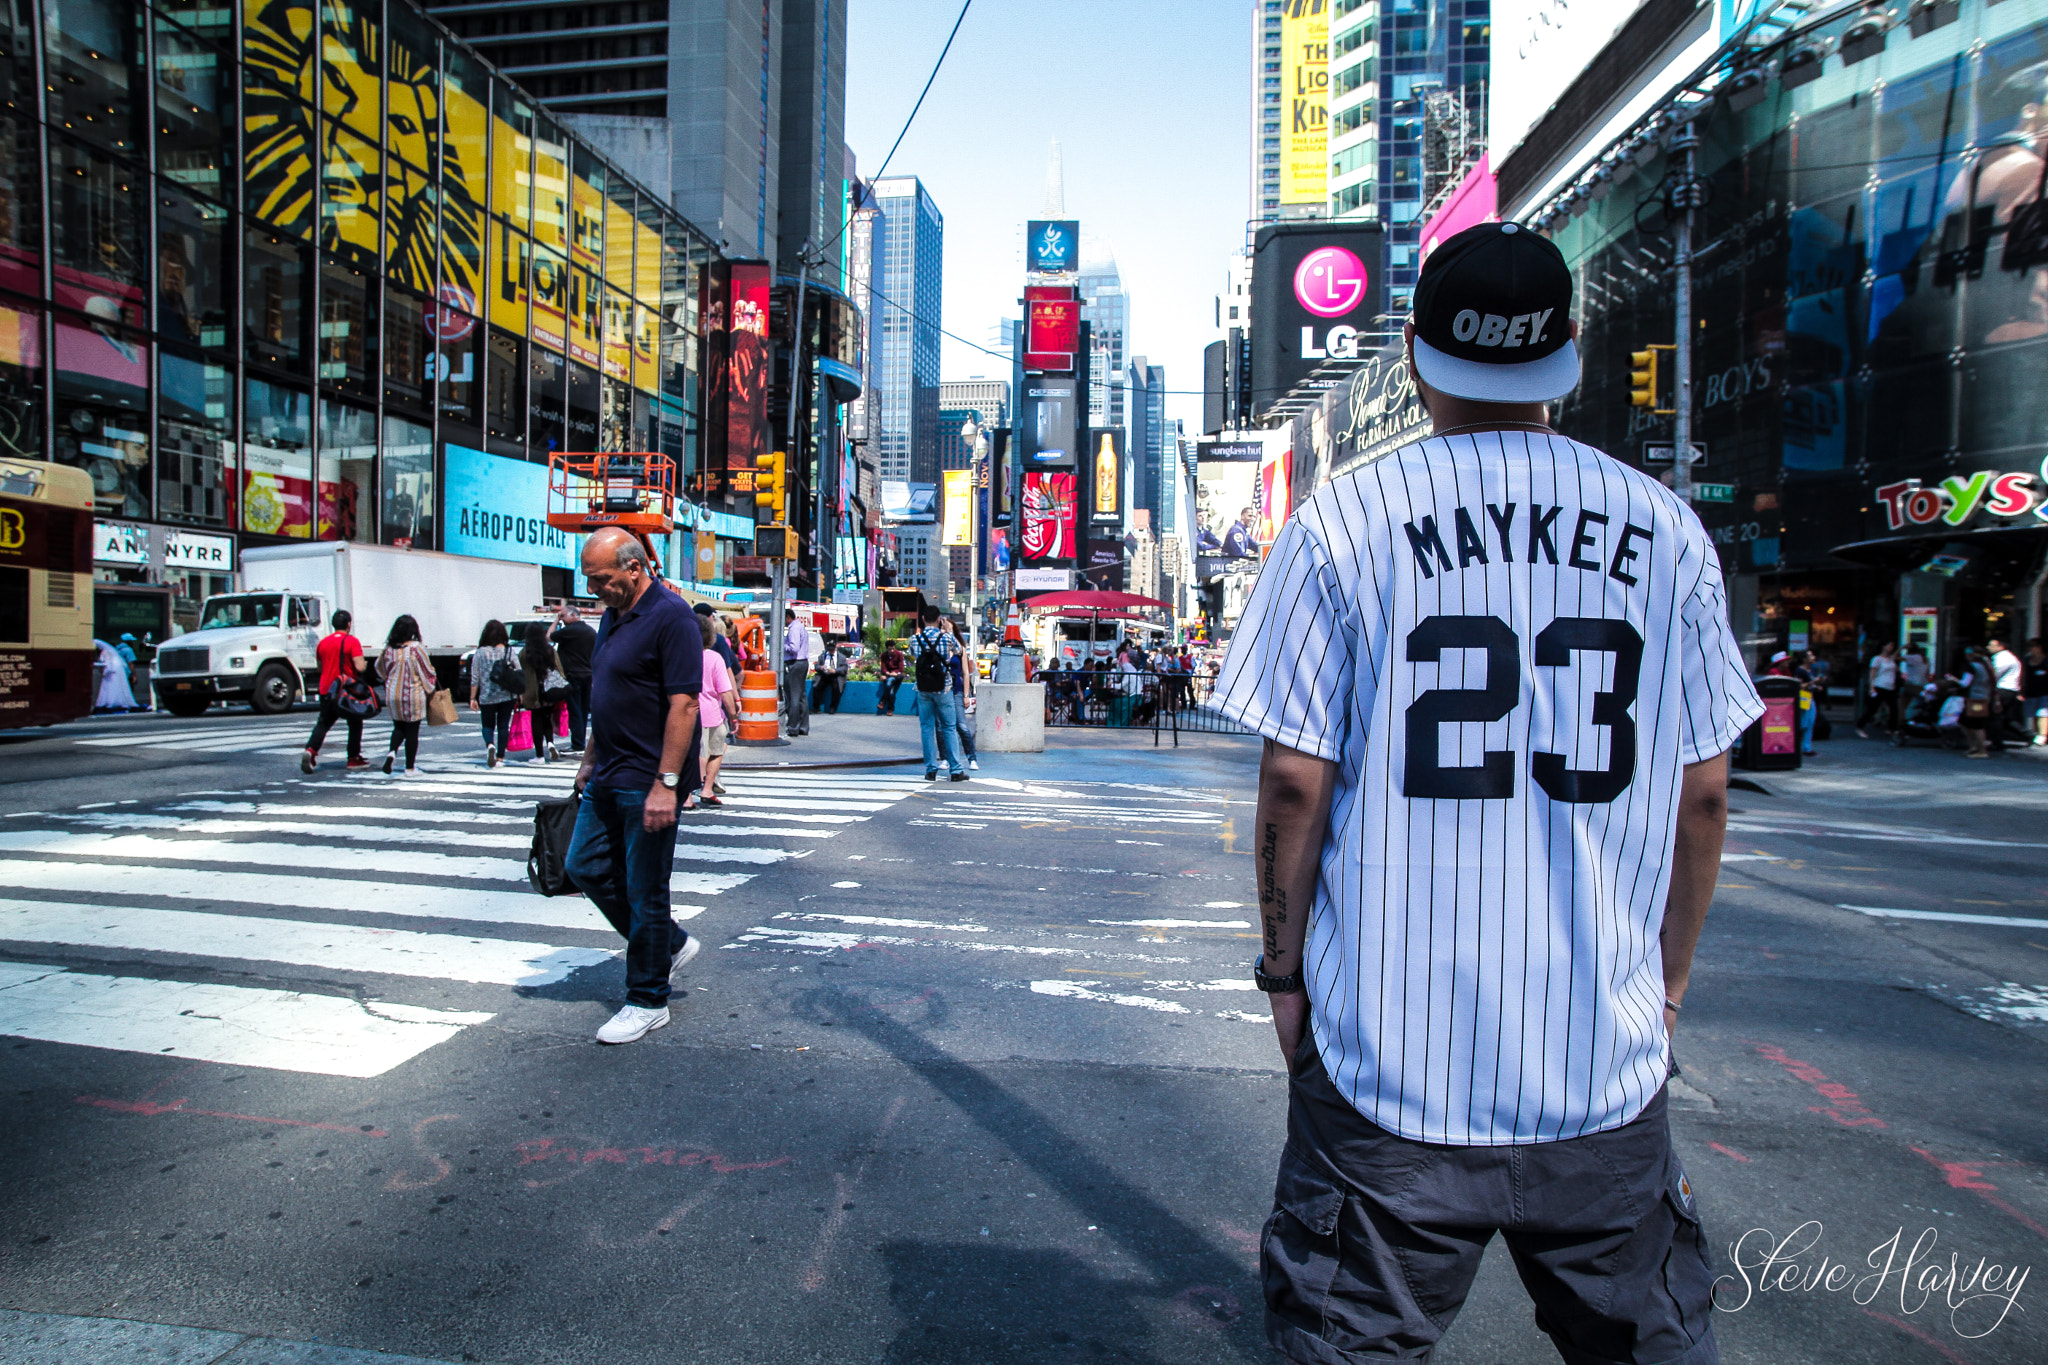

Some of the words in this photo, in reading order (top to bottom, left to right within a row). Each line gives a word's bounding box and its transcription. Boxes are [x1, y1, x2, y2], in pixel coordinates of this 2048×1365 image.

[1303, 44, 1328, 60] TH
[1297, 65, 1328, 95] LIO
[1292, 98, 1328, 133] KIN
[1301, 325, 1358, 359] LG
[1704, 352, 1773, 409] BOYS
[737, 471, 753, 480] GET
[1403, 503, 1654, 588] MAYKEE
[830, 619, 844, 630] TOUR
[1403, 615, 1645, 804] 23
